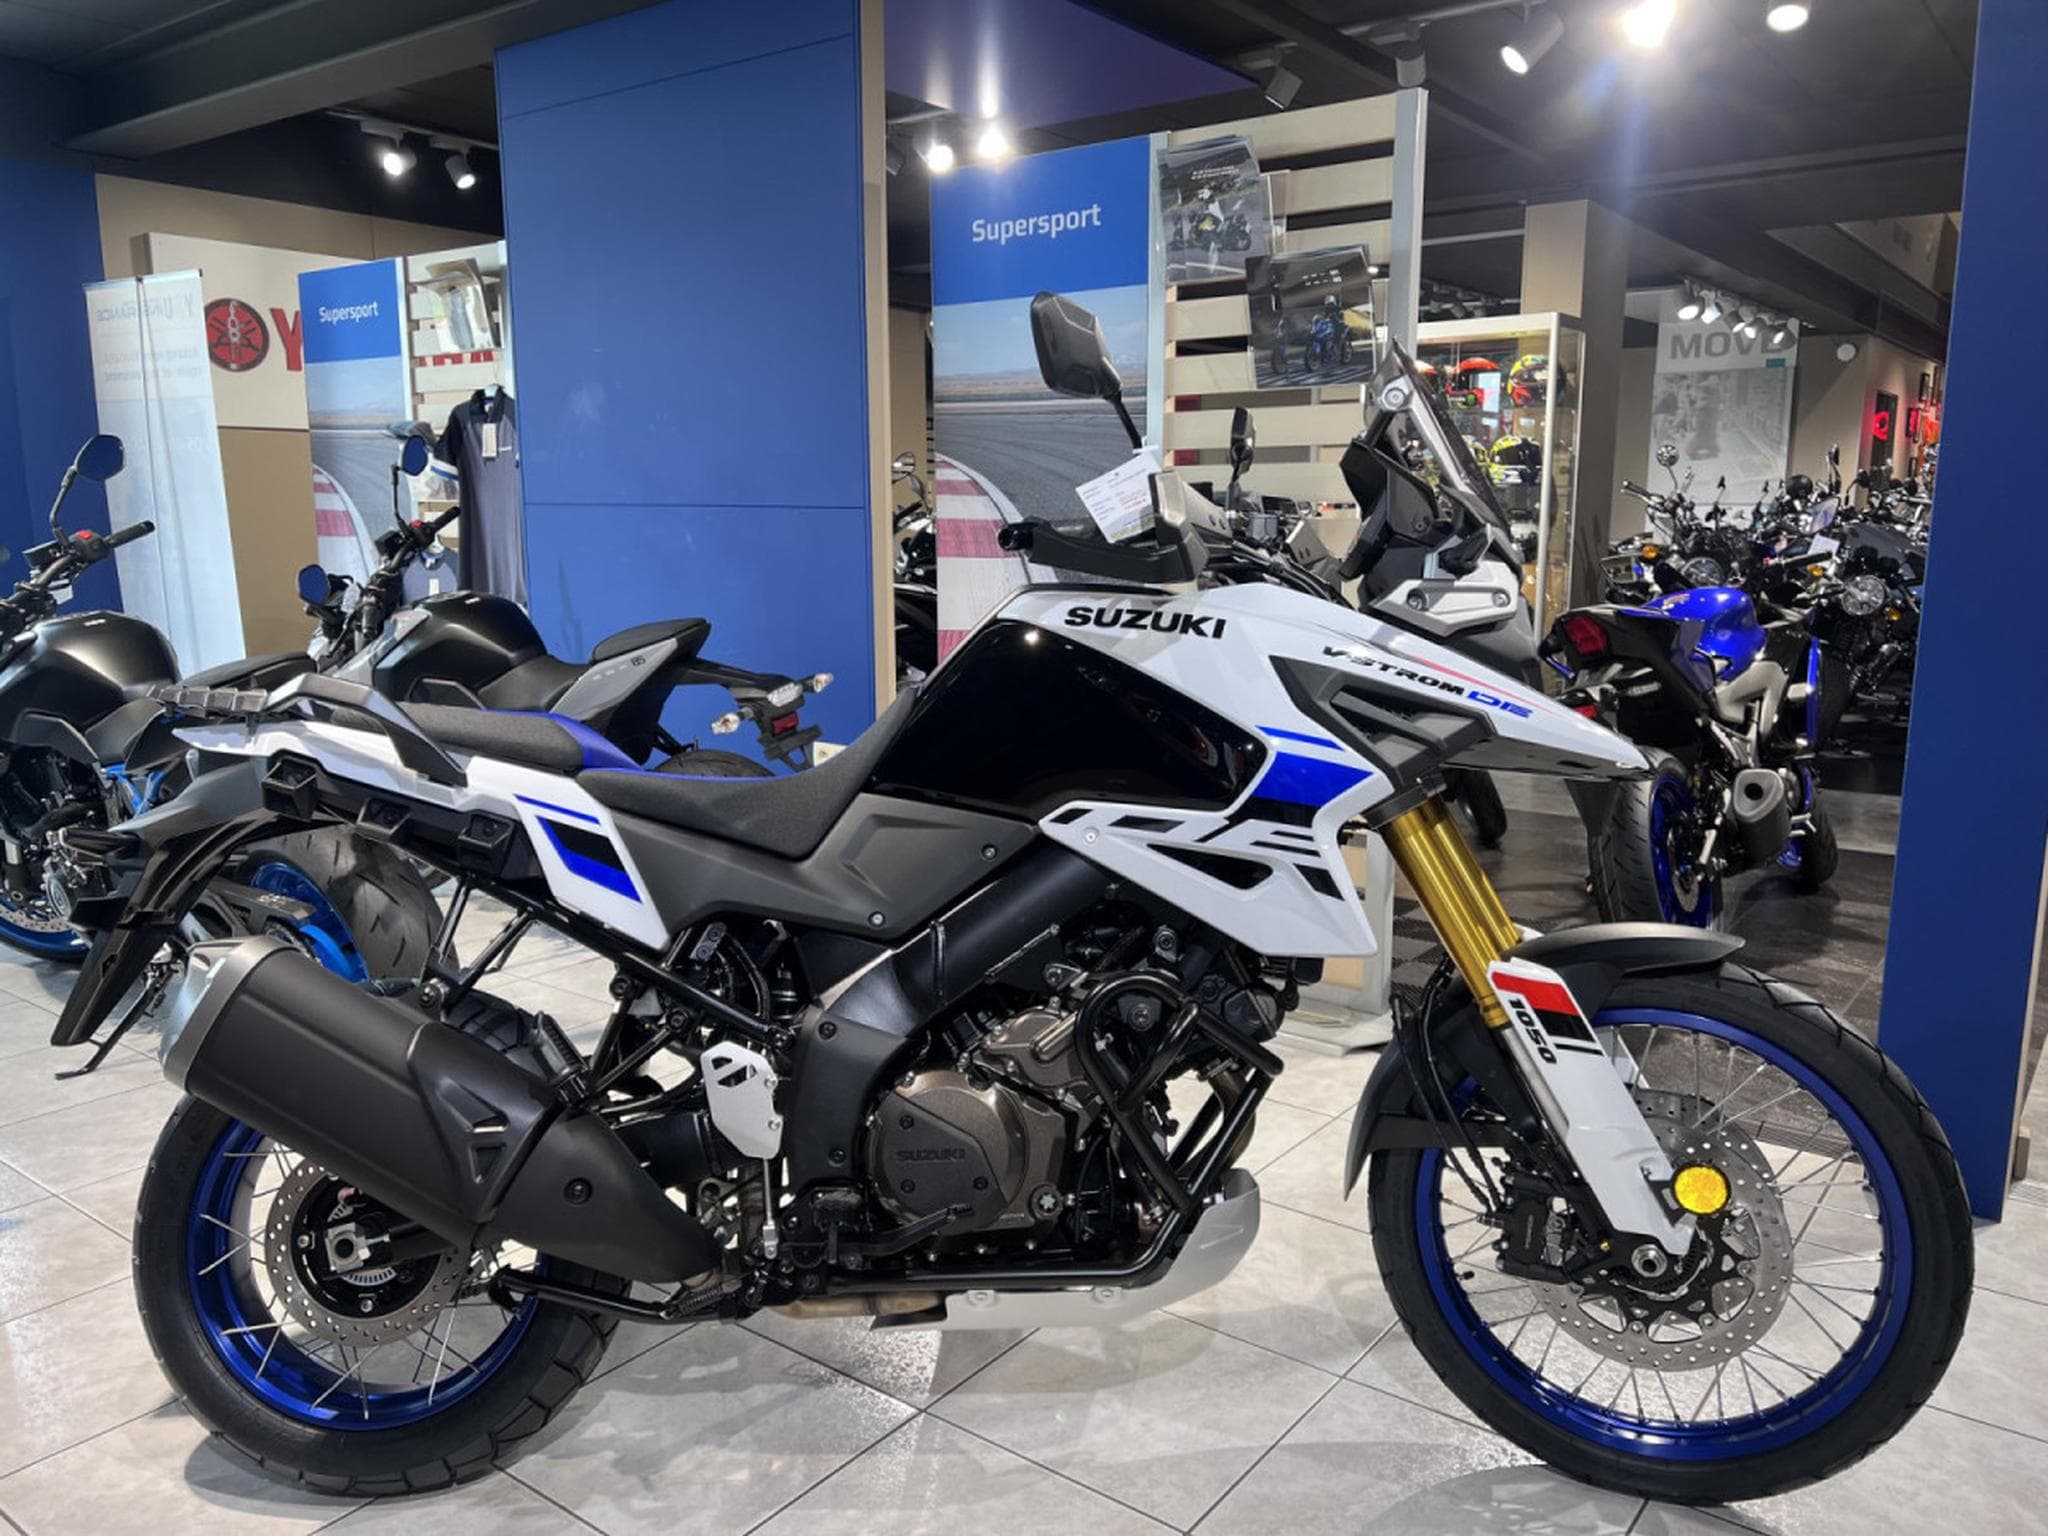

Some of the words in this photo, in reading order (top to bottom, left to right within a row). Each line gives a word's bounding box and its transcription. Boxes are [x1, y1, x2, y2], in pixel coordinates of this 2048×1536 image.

[972, 203, 1102, 246] Supersport
[318, 300, 380, 326] Supersport
[1064, 606, 1226, 639] SUZUKI
[1465, 690, 1533, 719] DE
[1508, 998, 1558, 1065] 1050
[896, 1148, 966, 1162] SUZUKI
